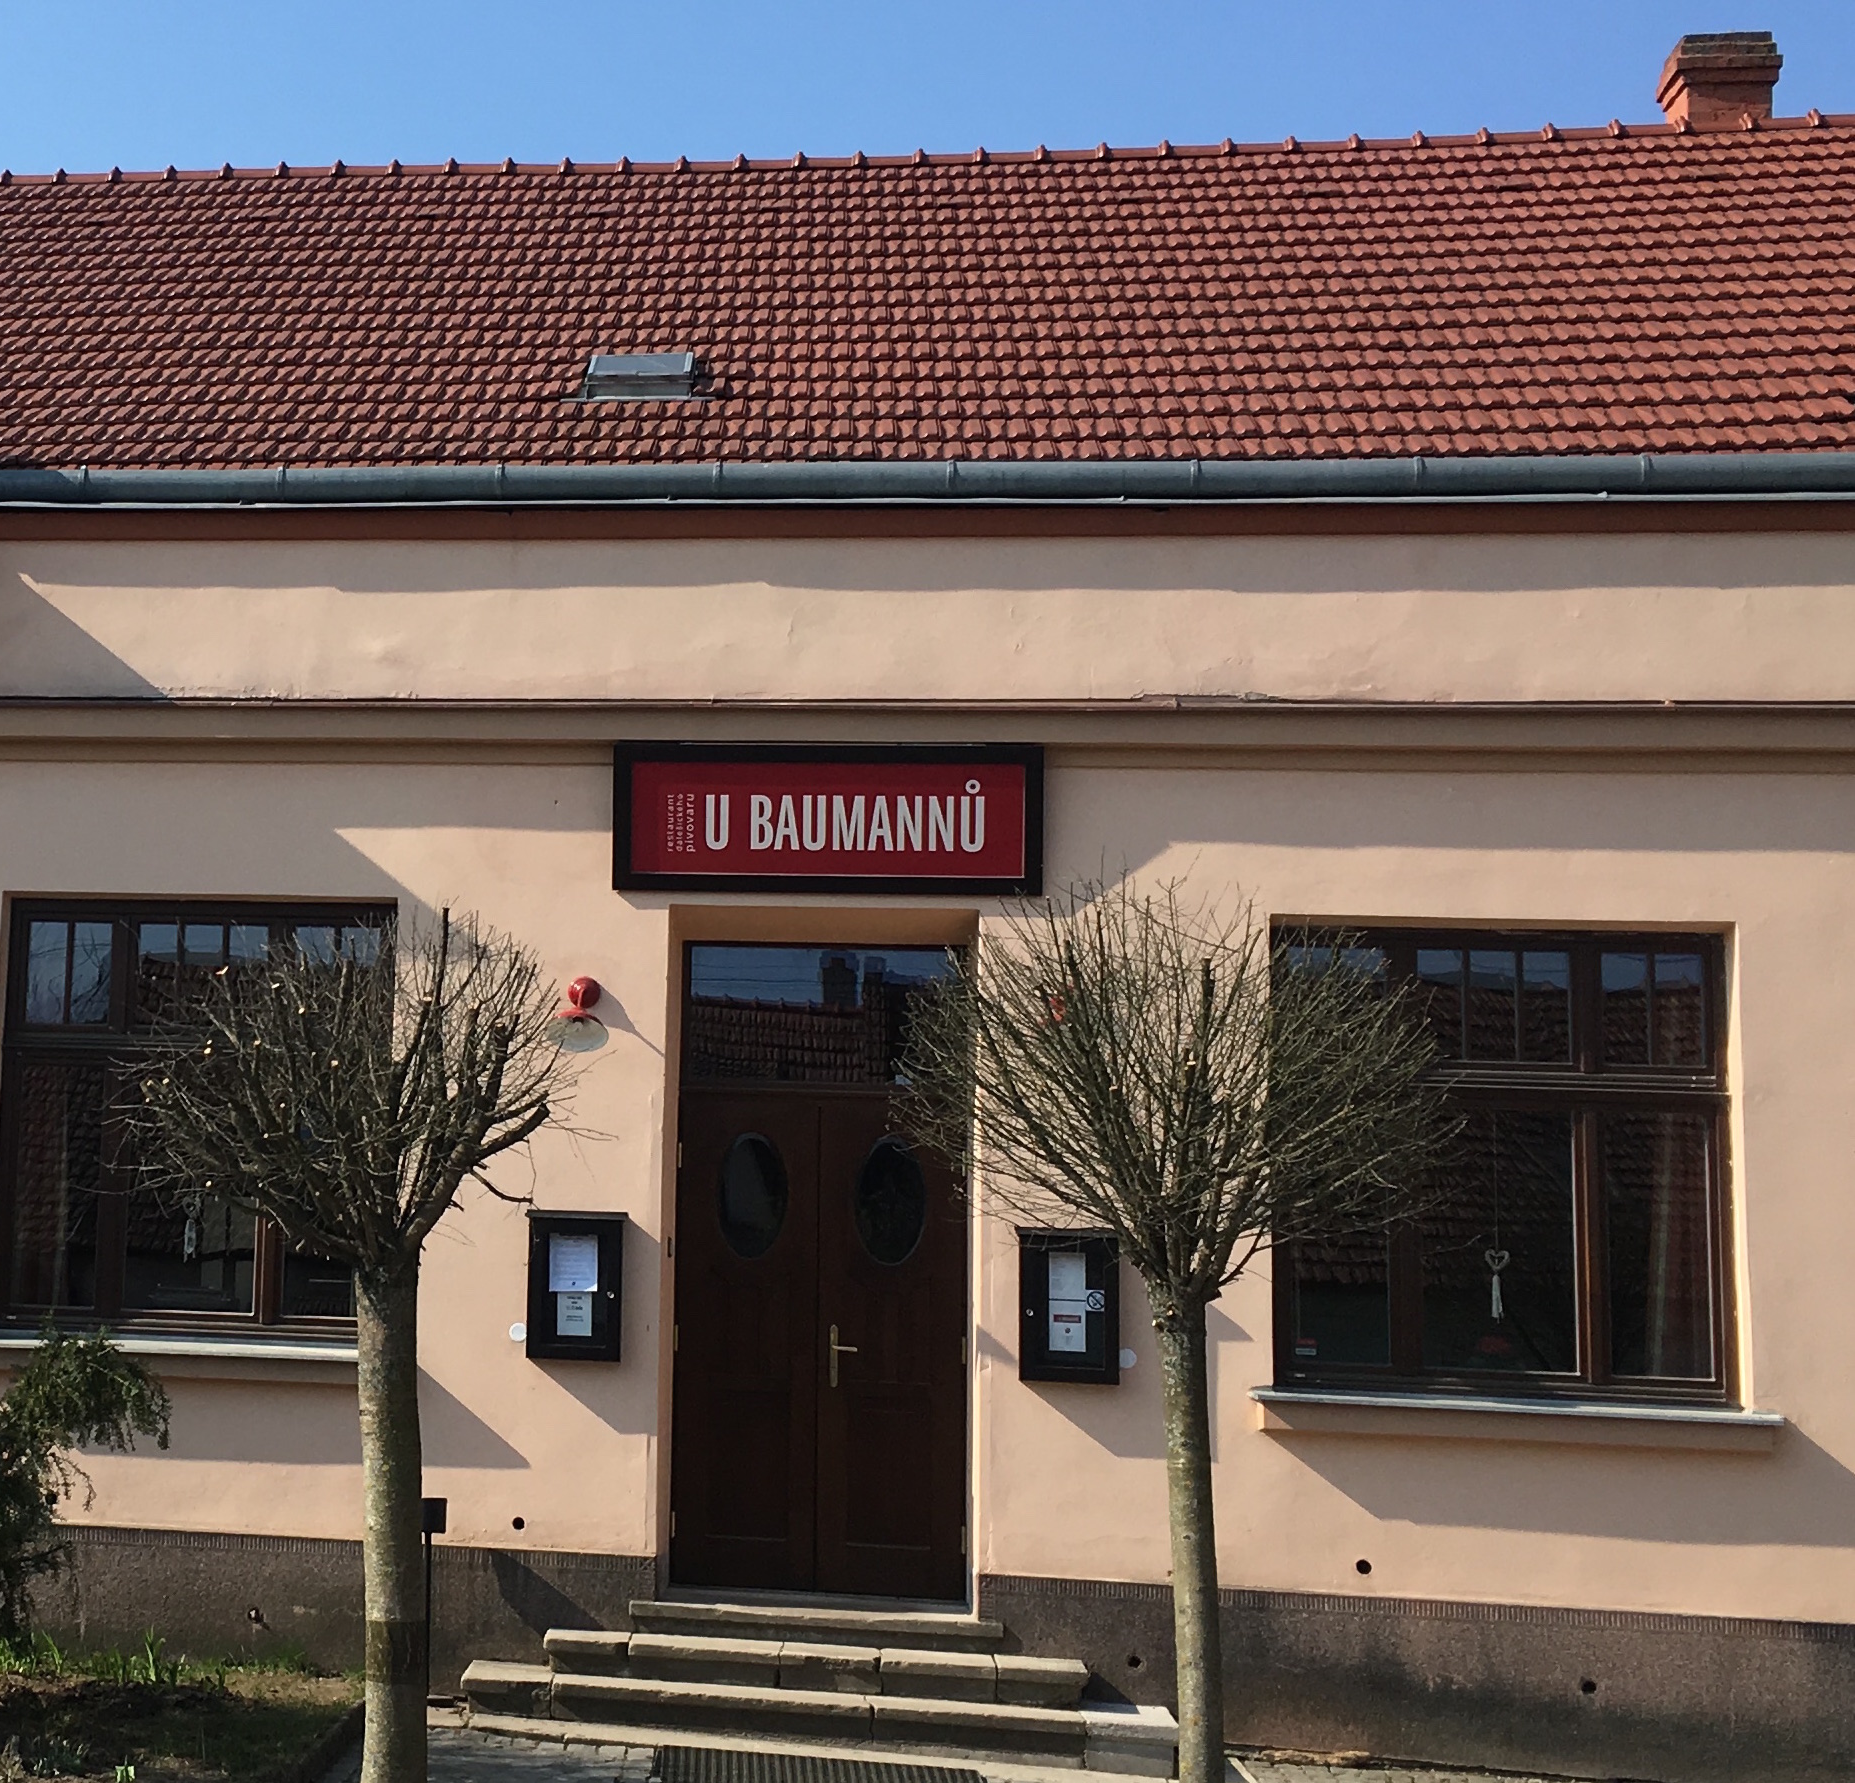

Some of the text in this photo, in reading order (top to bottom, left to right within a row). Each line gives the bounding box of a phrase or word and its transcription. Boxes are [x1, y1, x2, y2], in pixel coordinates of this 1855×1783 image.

[667, 794, 675, 852] restaurant
[685, 794, 696, 852] pivovaru
[704, 779, 985, 853] U BAUMANNŮ
